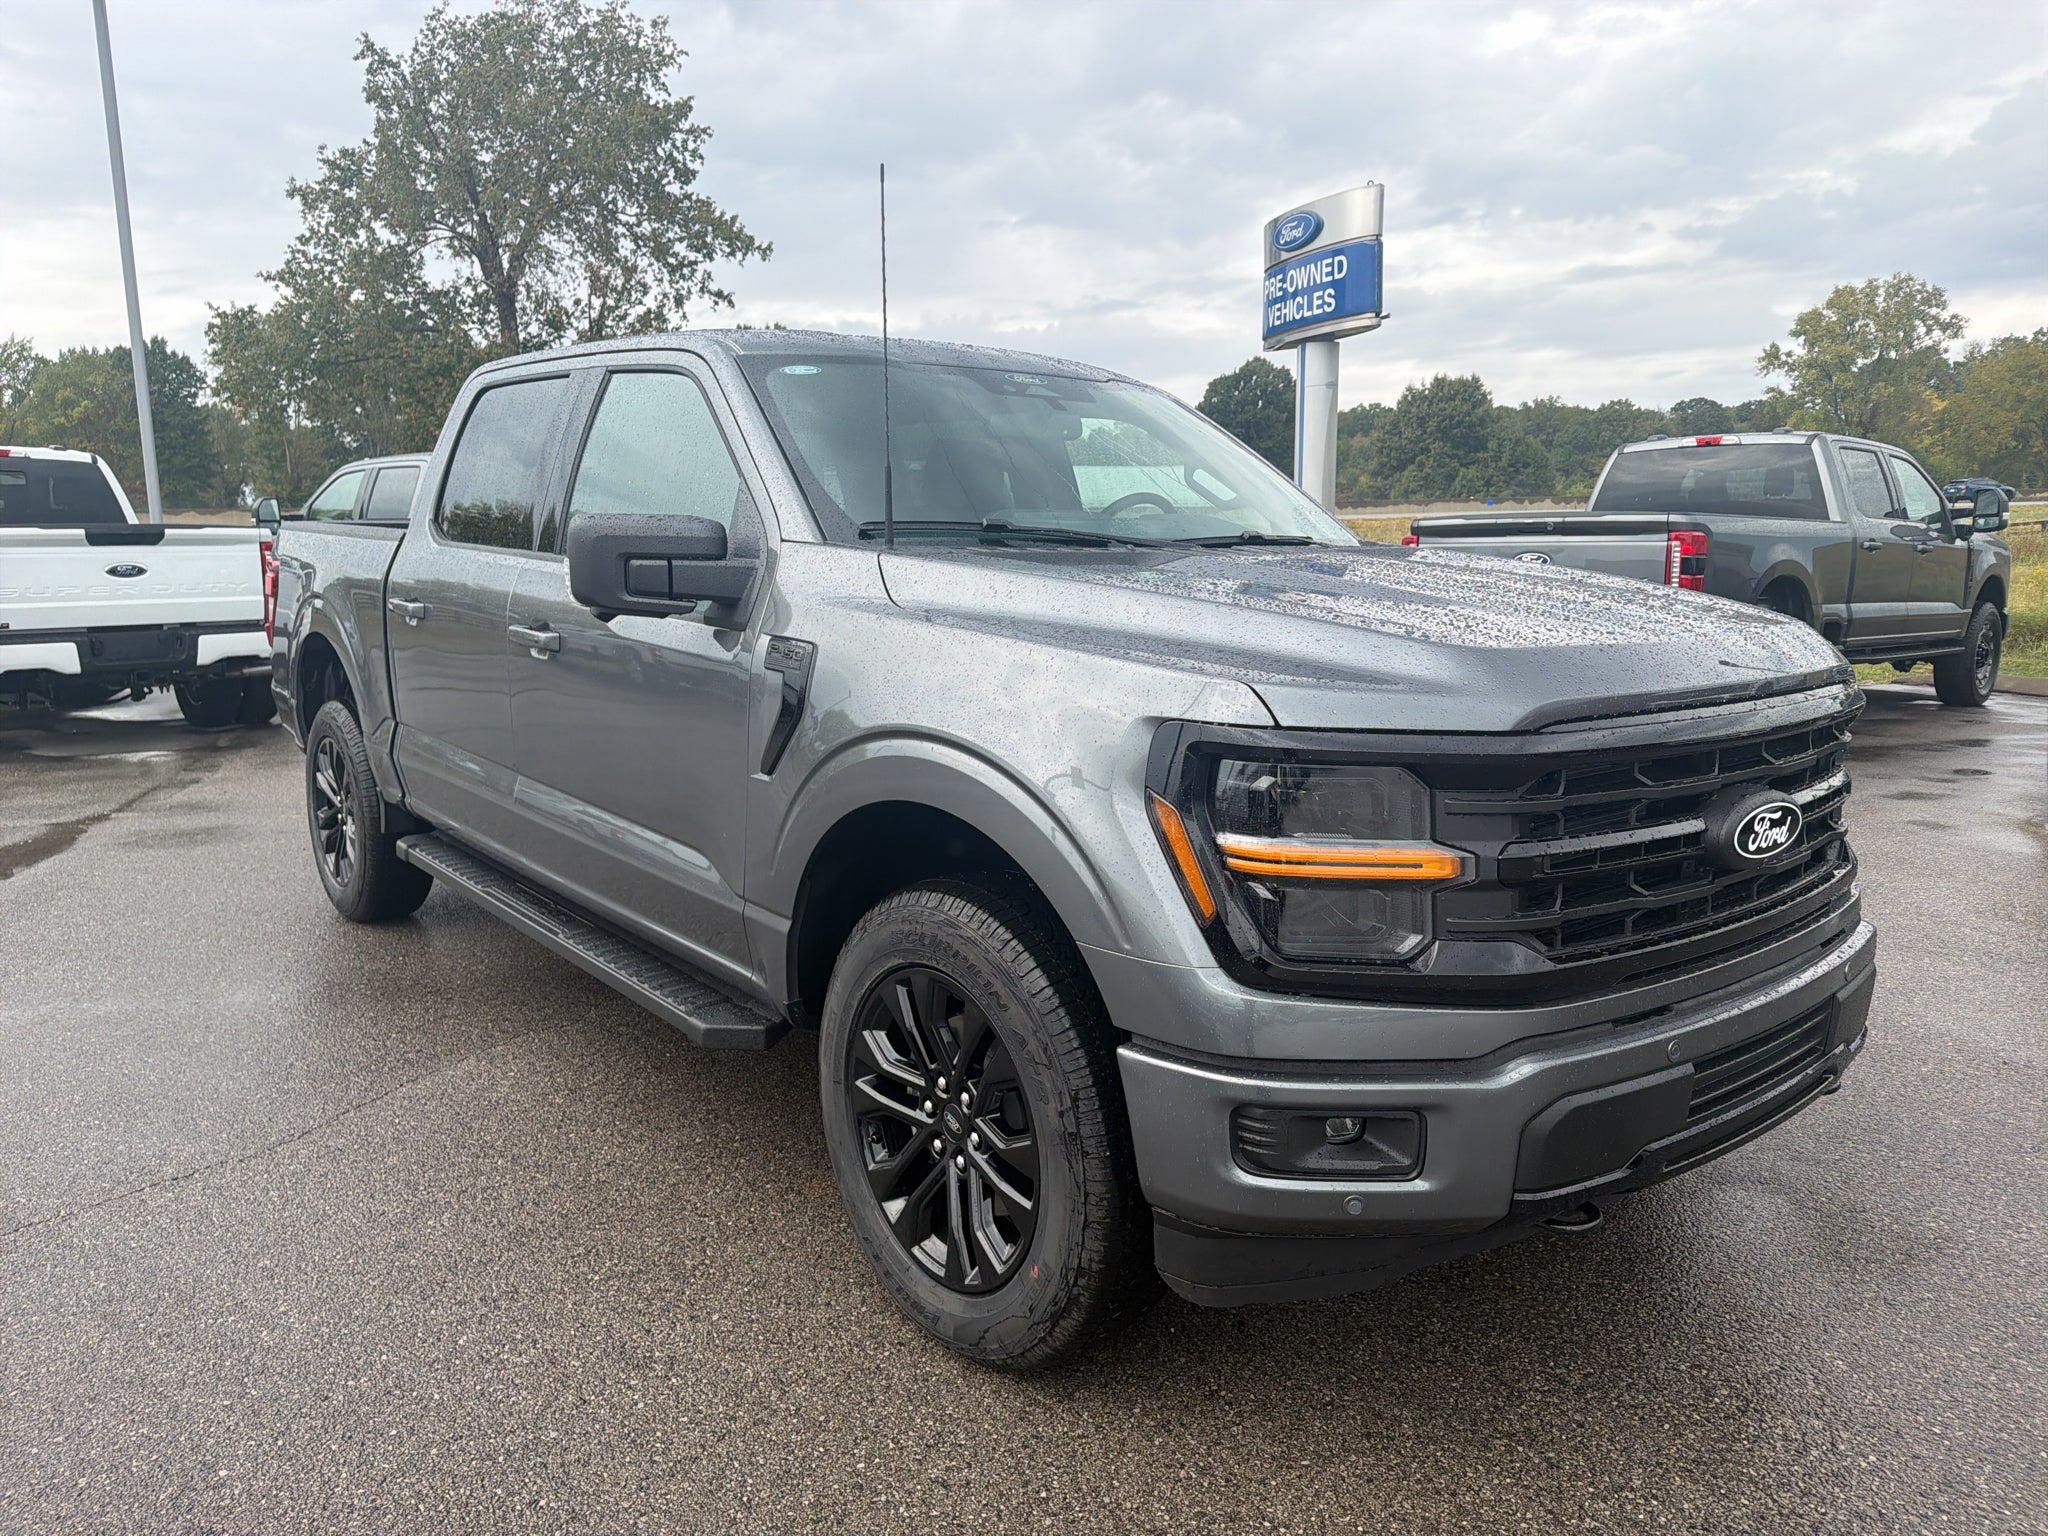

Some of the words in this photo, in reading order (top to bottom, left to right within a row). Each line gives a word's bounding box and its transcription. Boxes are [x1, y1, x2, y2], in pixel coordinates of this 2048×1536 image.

[1279, 221, 1305, 245] Ford
[1264, 255, 1348, 303] PRE-OWNED
[1268, 288, 1336, 328] VEHICLES
[0, 583, 141, 598] SUPER
[151, 582, 249, 594] DUTY
[116, 565, 139, 576] Ford
[1747, 810, 1792, 852] Ford
[888, 928, 1010, 1013] SCORPION
